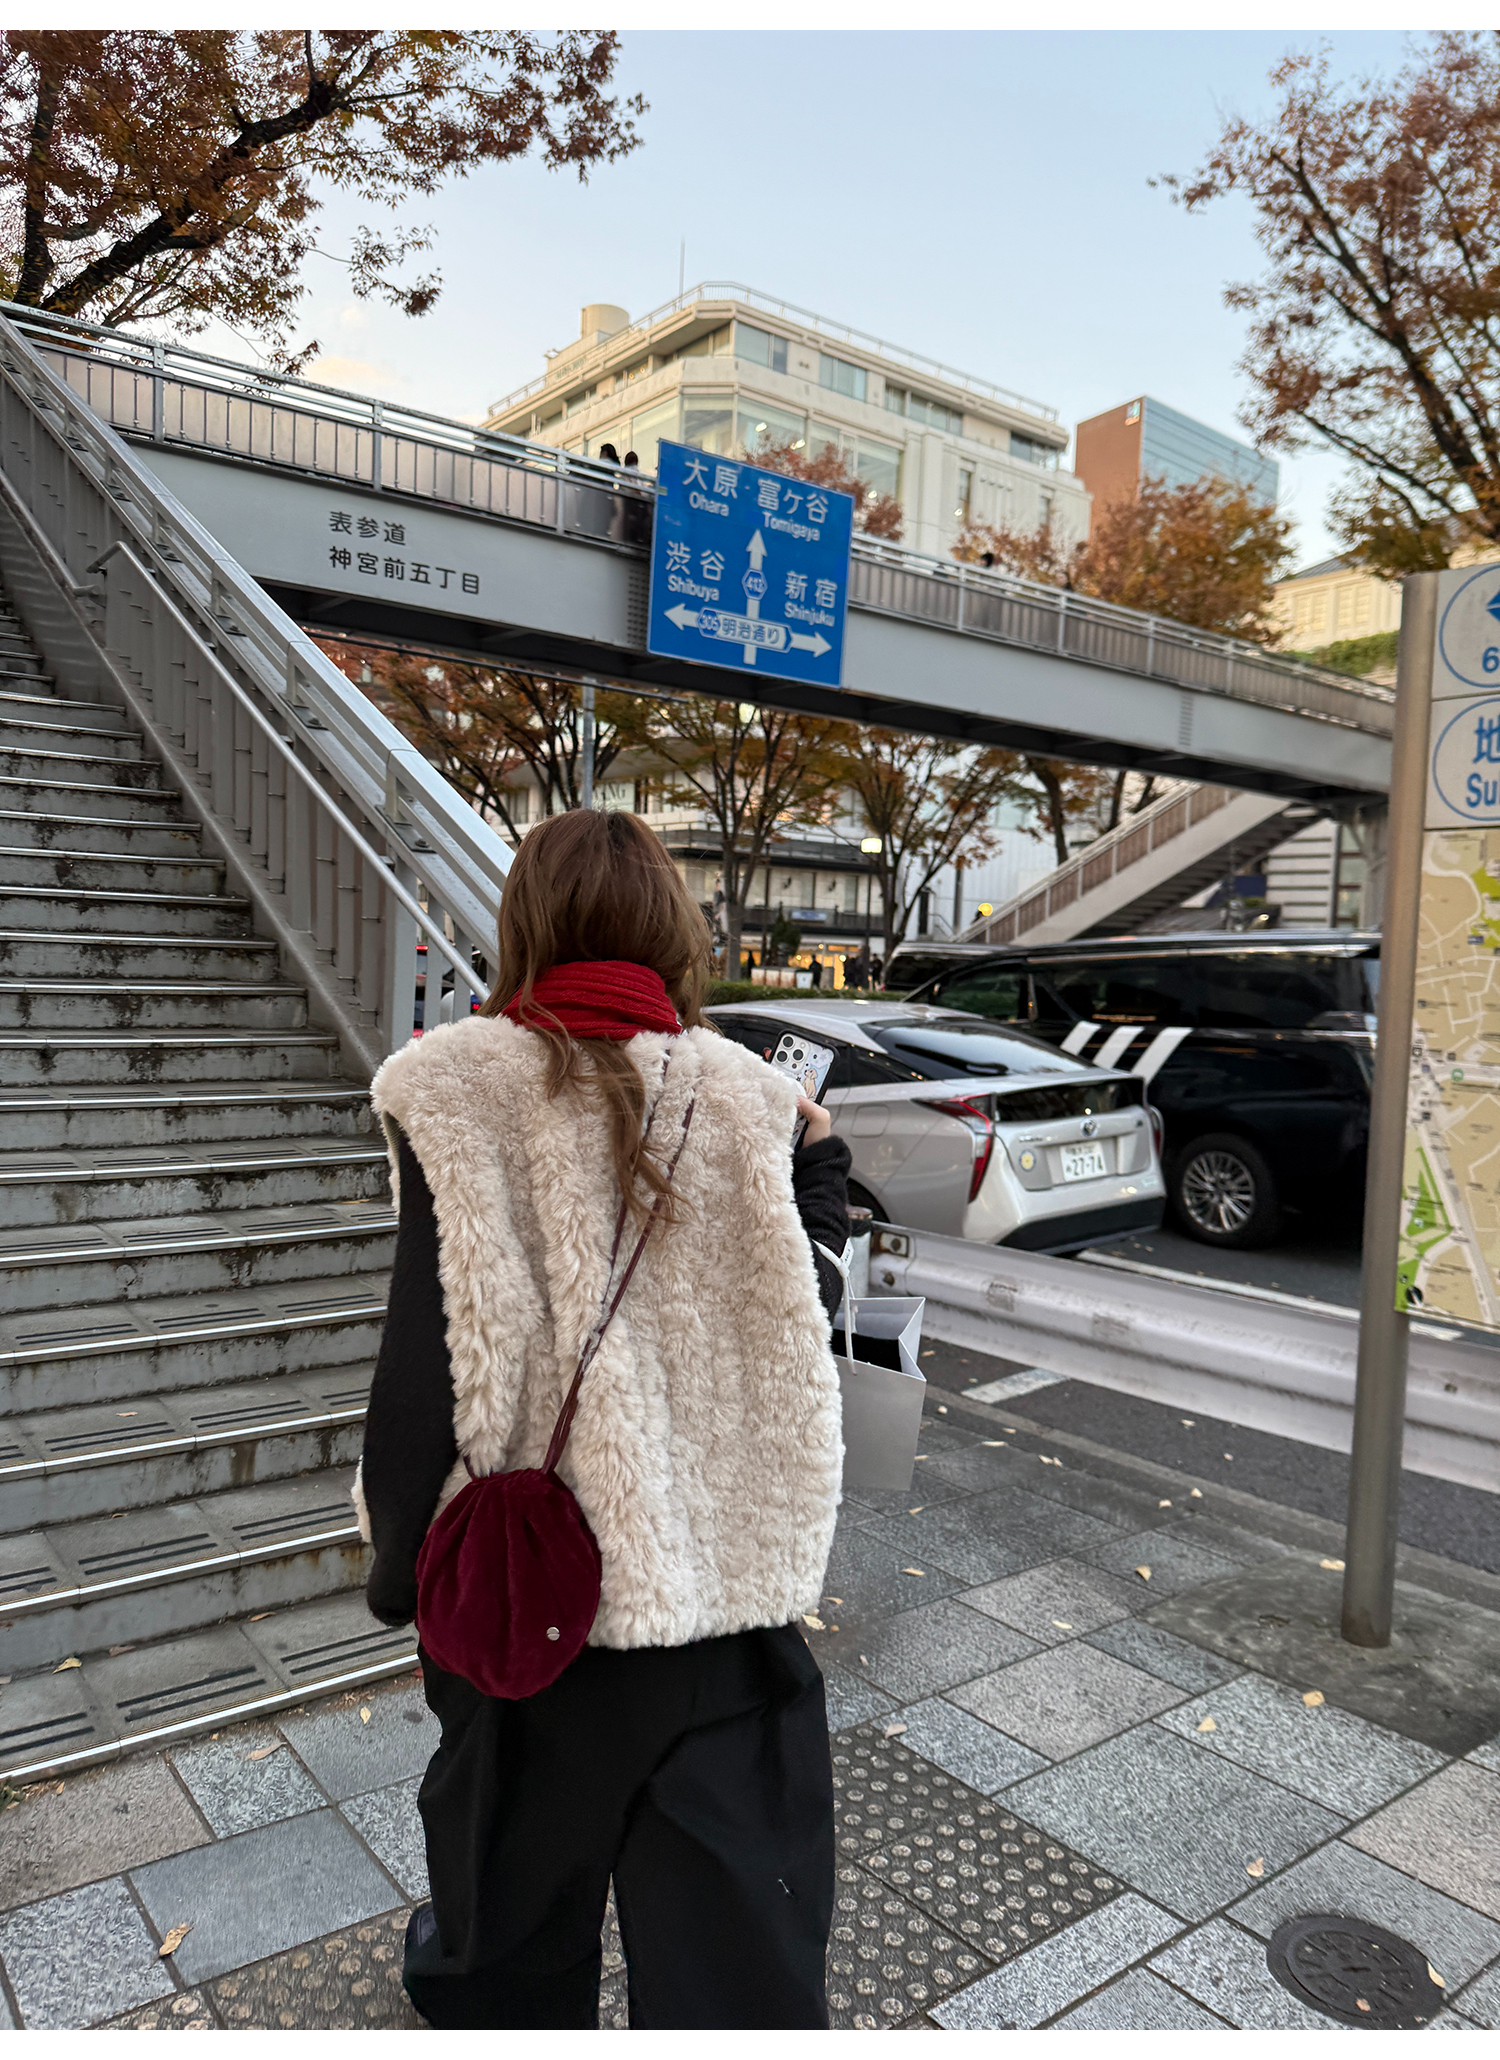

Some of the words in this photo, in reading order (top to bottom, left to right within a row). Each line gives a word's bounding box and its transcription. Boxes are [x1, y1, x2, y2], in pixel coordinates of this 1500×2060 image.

[329, 511, 406, 546] 表参道
[689, 491, 729, 516] Ohara
[762, 511, 820, 542] Tomigaya
[329, 546, 480, 595] 神宮前五丁目
[665, 540, 725, 581] 渋谷
[667, 574, 720, 602] Shibuya
[784, 570, 838, 609] 新宿
[700, 614, 720, 632] 305
[722, 618, 780, 645] 明治通り
[784, 601, 836, 628] Shinjuku
